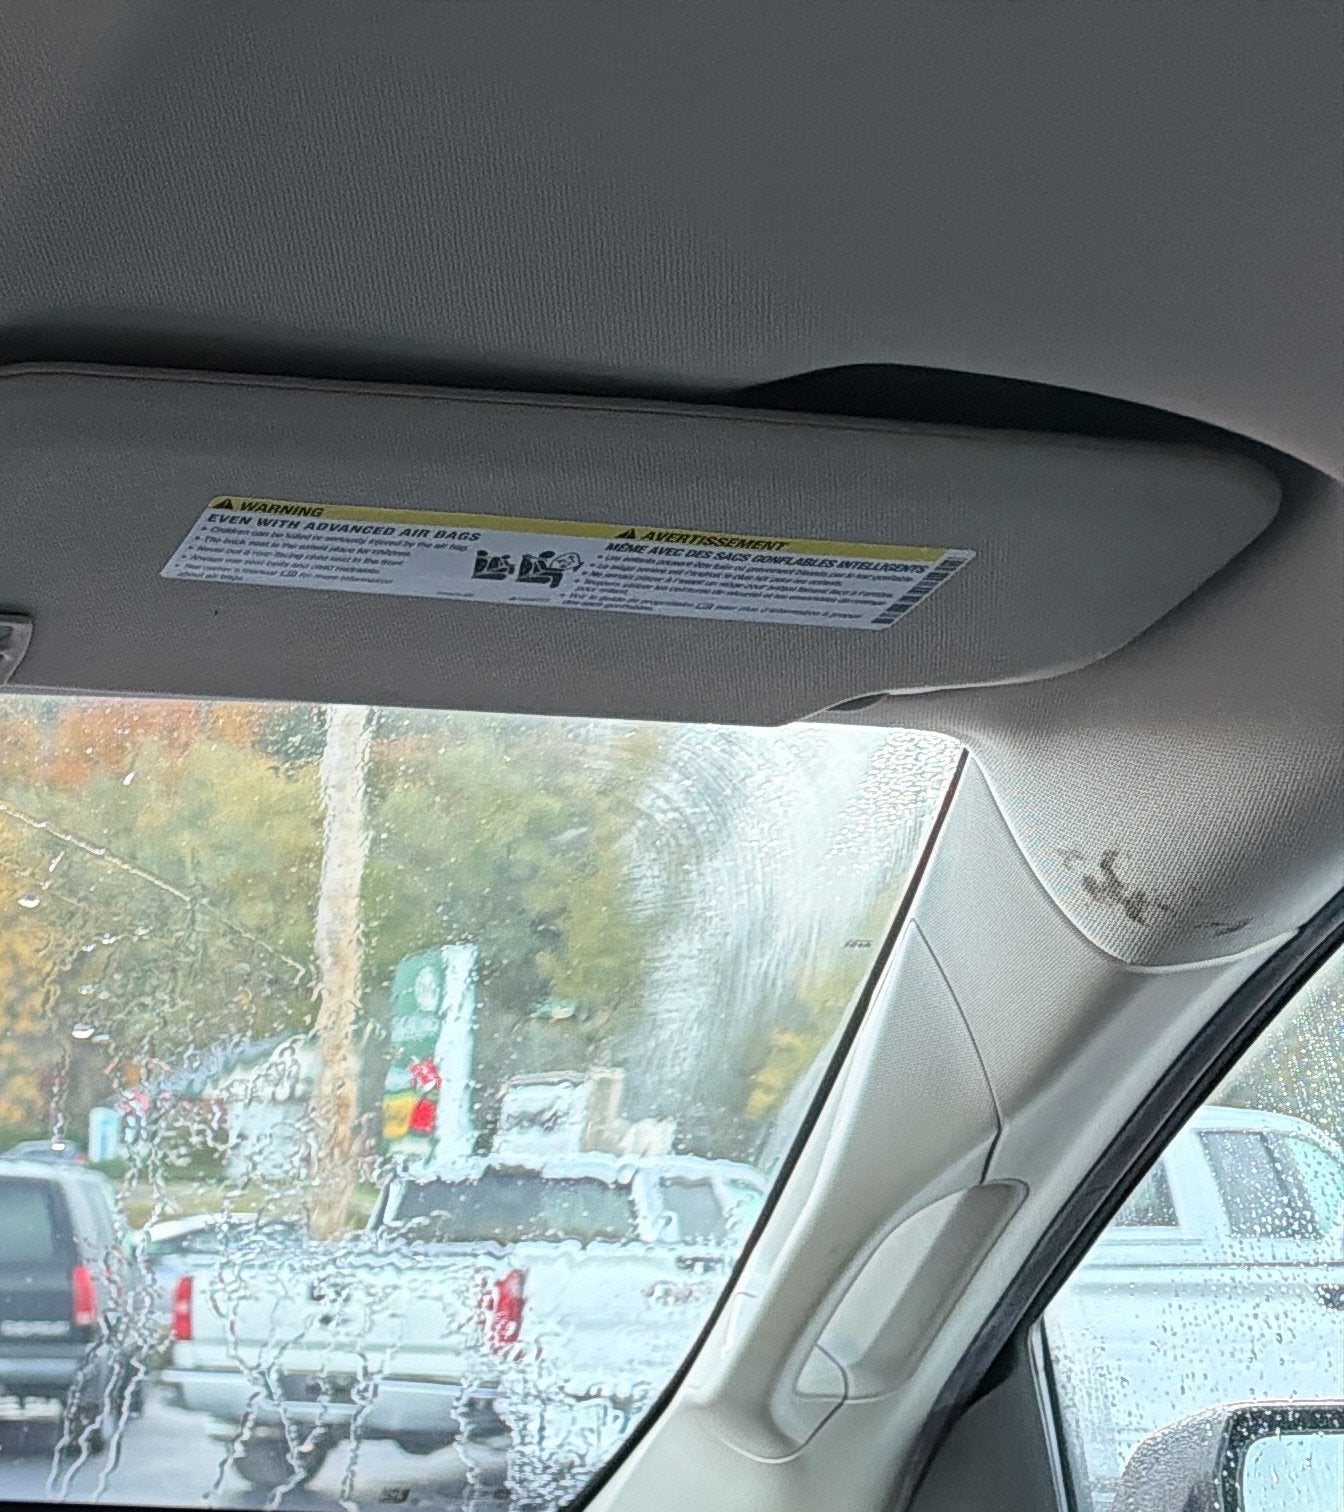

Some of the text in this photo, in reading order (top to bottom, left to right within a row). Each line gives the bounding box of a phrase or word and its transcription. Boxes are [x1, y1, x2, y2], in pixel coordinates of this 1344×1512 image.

[240, 501, 324, 517] WARNING
[207, 513, 482, 542] EVEN WITH ADVANCED AIR BAGS
[640, 530, 790, 551] AVERTISSEMENT
[649, 546, 685, 557] AVEC
[685, 549, 714, 560] DES
[713, 551, 751, 562] SACS
[837, 559, 929, 574] INTELLIGENTS
